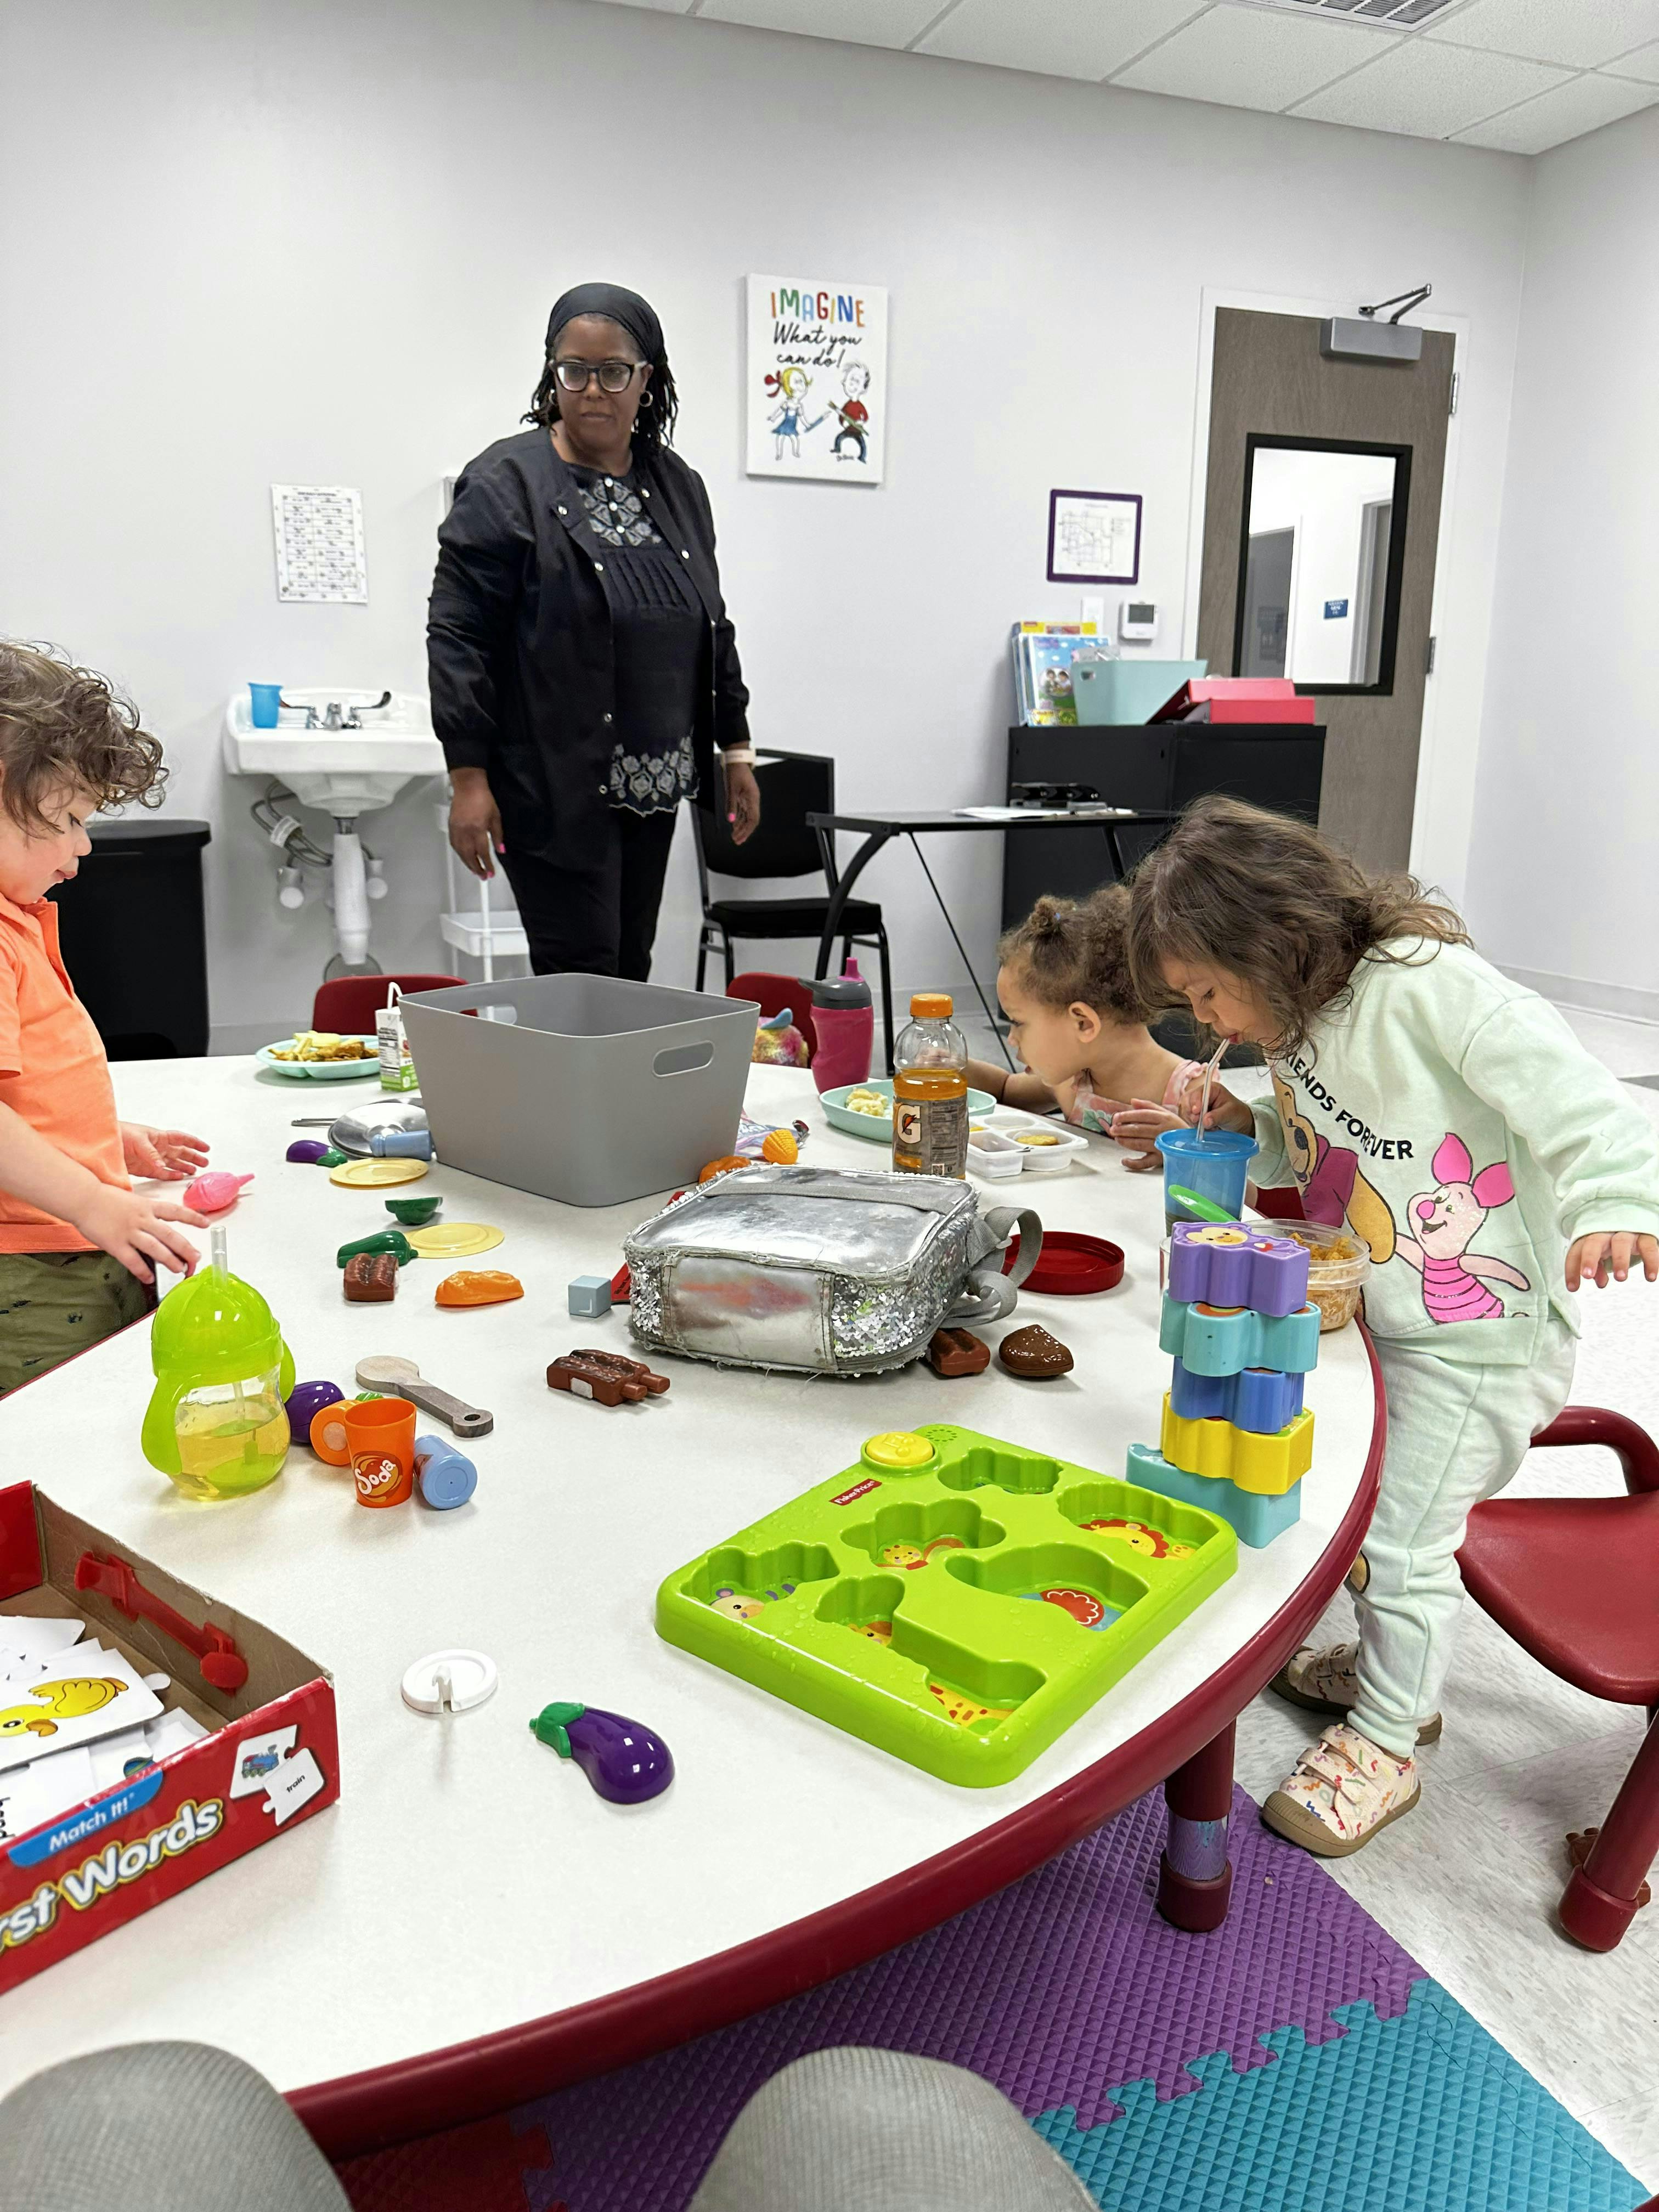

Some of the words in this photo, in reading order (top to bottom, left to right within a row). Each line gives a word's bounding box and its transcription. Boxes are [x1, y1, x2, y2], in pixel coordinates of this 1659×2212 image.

[771, 288, 865, 328] IMAGINE
[774, 321, 827, 345] What
[829, 335, 862, 356] you
[776, 354, 811, 364] can
[812, 348, 845, 368] do!
[898, 1104, 921, 1144] G
[1286, 1052, 1336, 1111] IENDS
[1335, 1109, 1414, 1160] FOREVER
[354, 1459, 396, 1494] Soda
[286, 1775, 305, 1793] train
[49, 1811, 107, 1852] Match
[111, 1797, 128, 1818] It!
[64, 1802, 221, 1906] Words
